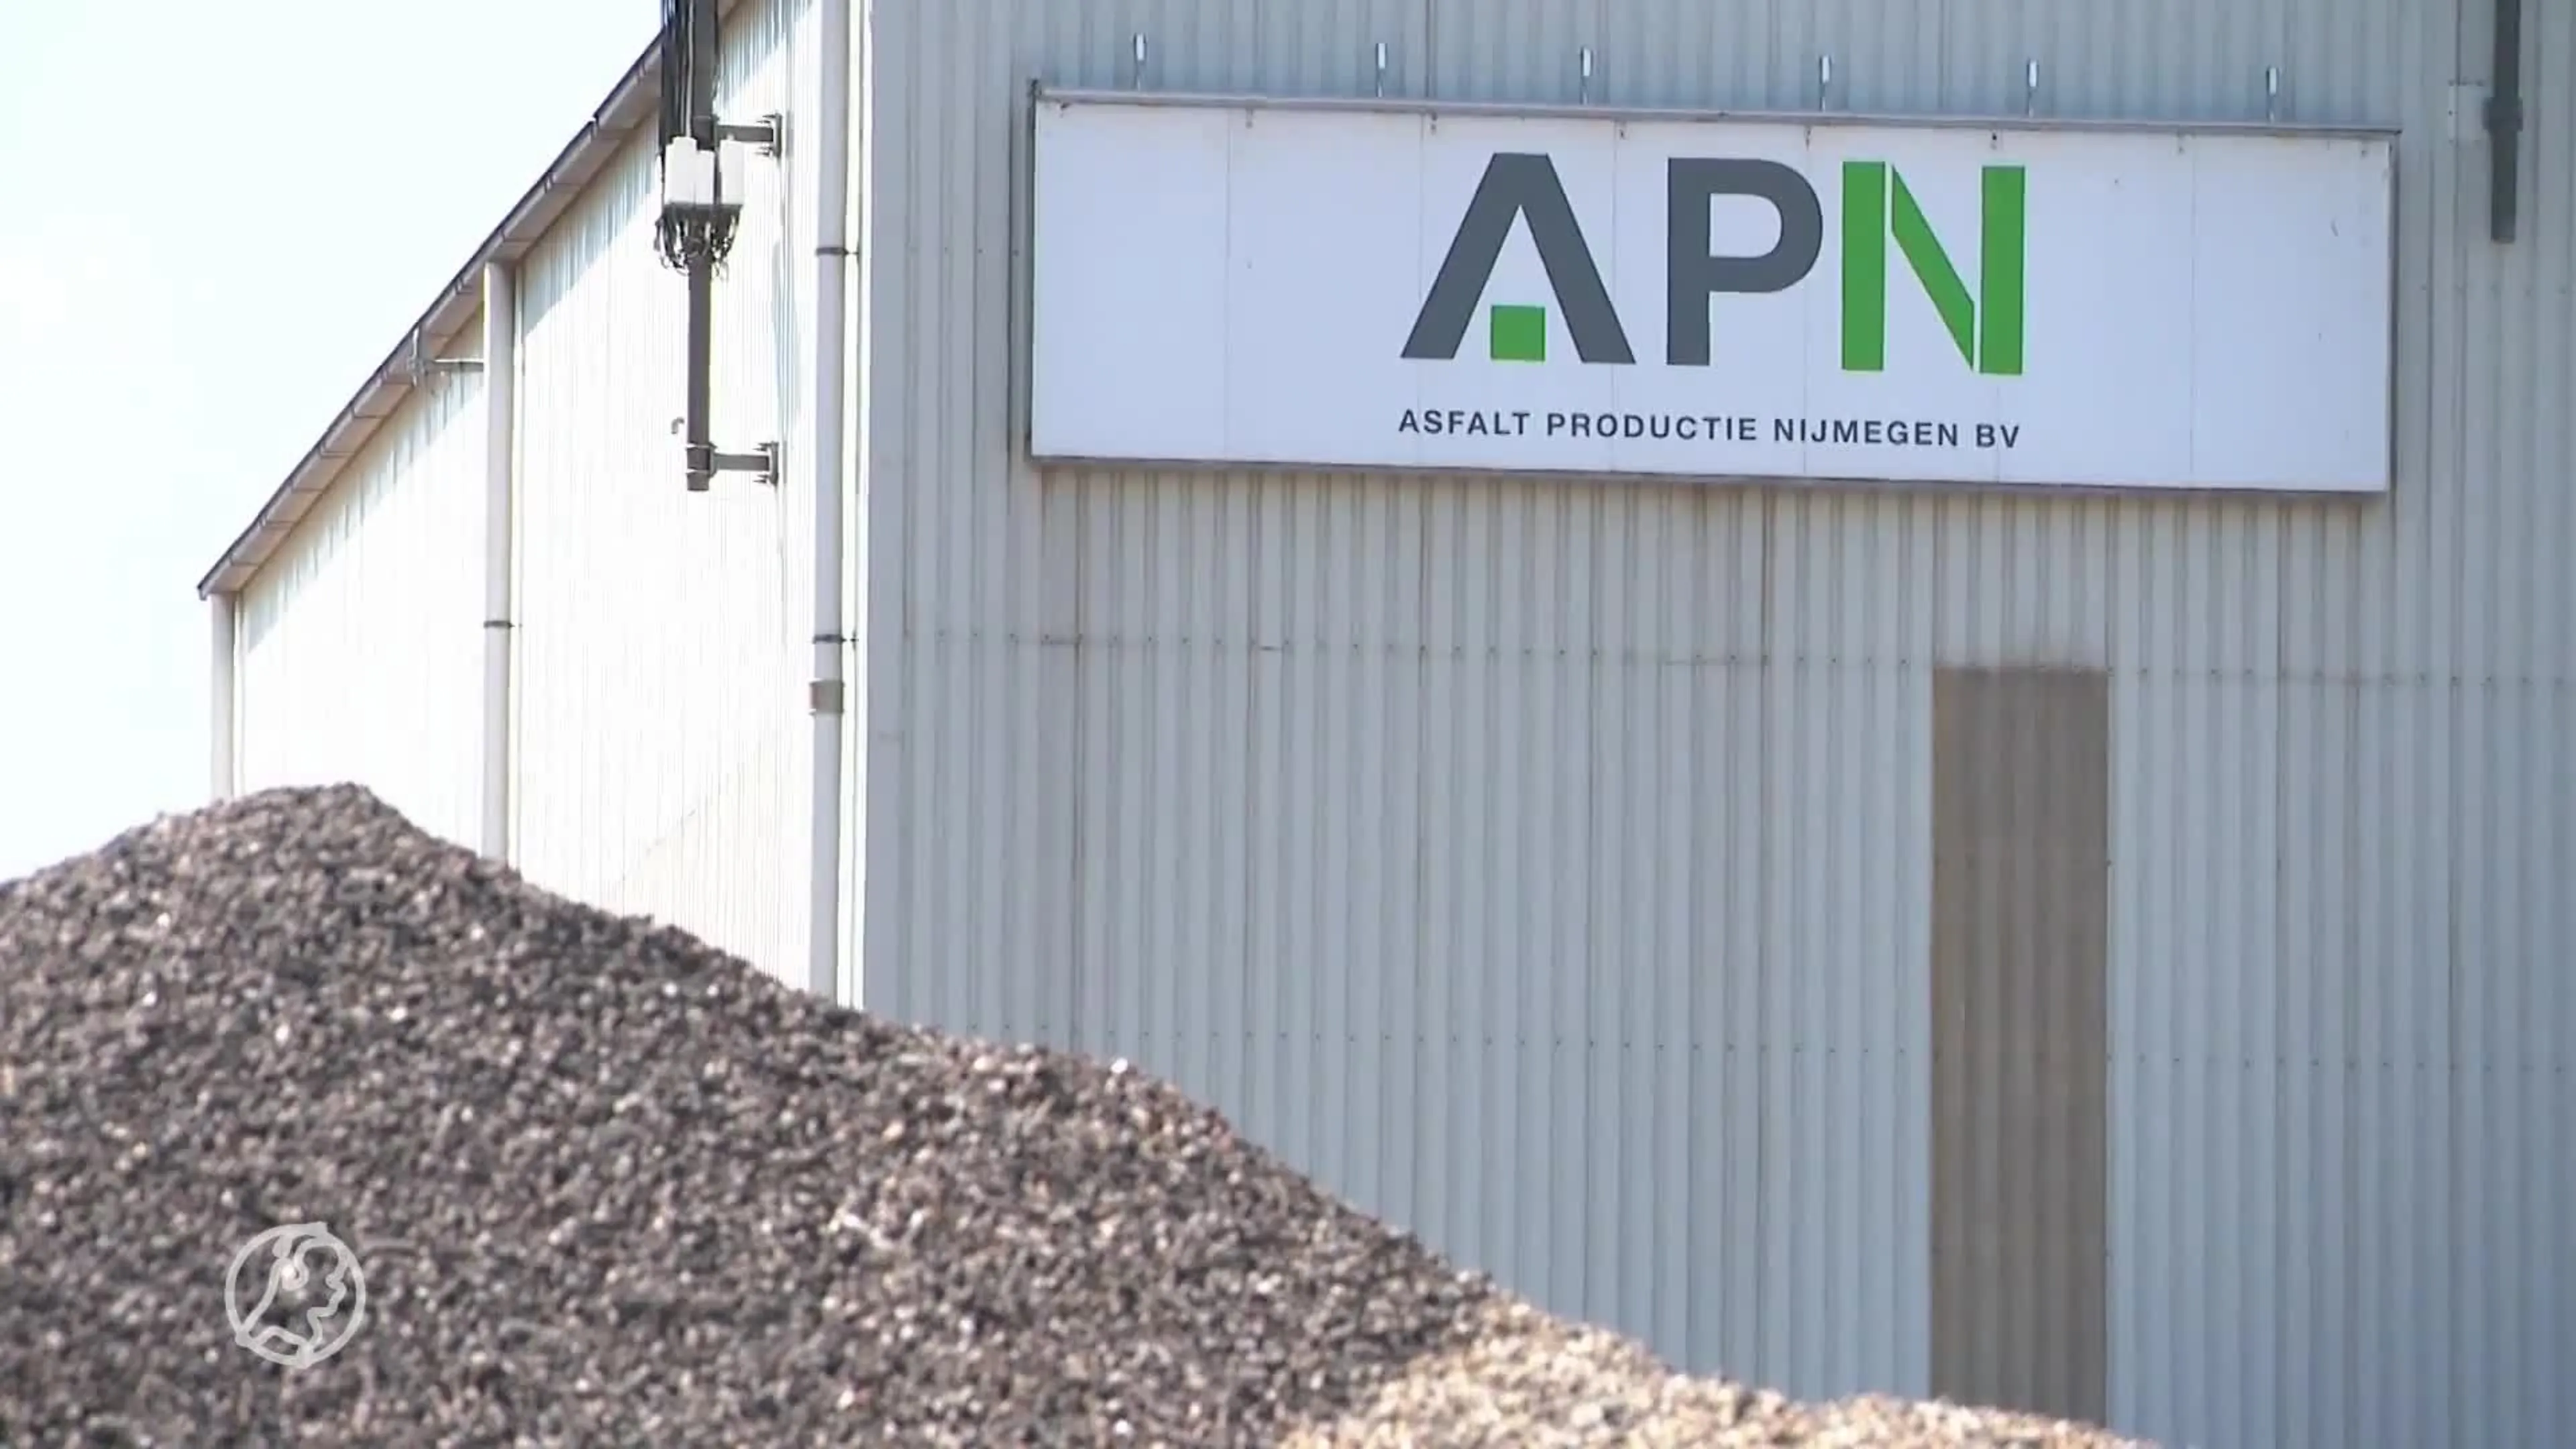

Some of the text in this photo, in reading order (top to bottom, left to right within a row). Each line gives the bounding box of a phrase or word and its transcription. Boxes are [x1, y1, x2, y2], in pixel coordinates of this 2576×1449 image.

[1399, 152, 2026, 376] APN
[1398, 409, 2020, 449] ASFALT PRODUCTIE NIJMEGEN BV
